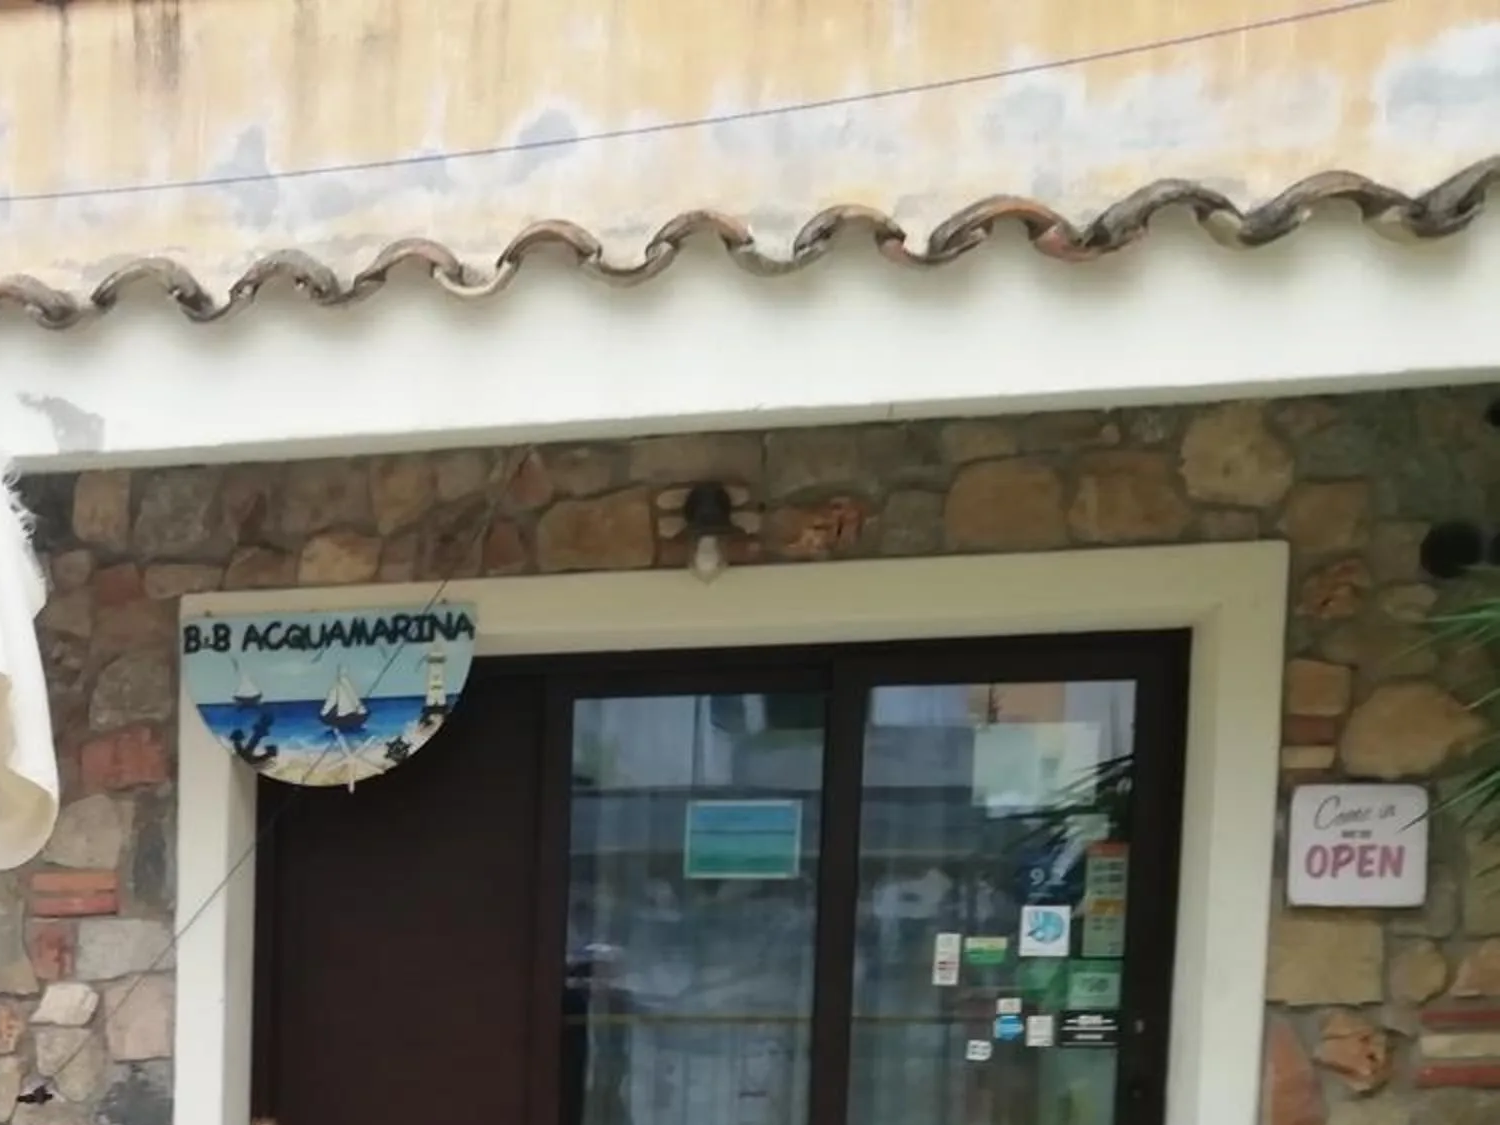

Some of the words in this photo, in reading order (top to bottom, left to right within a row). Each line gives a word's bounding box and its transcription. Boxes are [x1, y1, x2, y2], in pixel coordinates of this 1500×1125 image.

[241, 611, 476, 652] ACQUAMARINA
[1314, 795, 1374, 830] Come
[1305, 844, 1405, 879] OPEN
